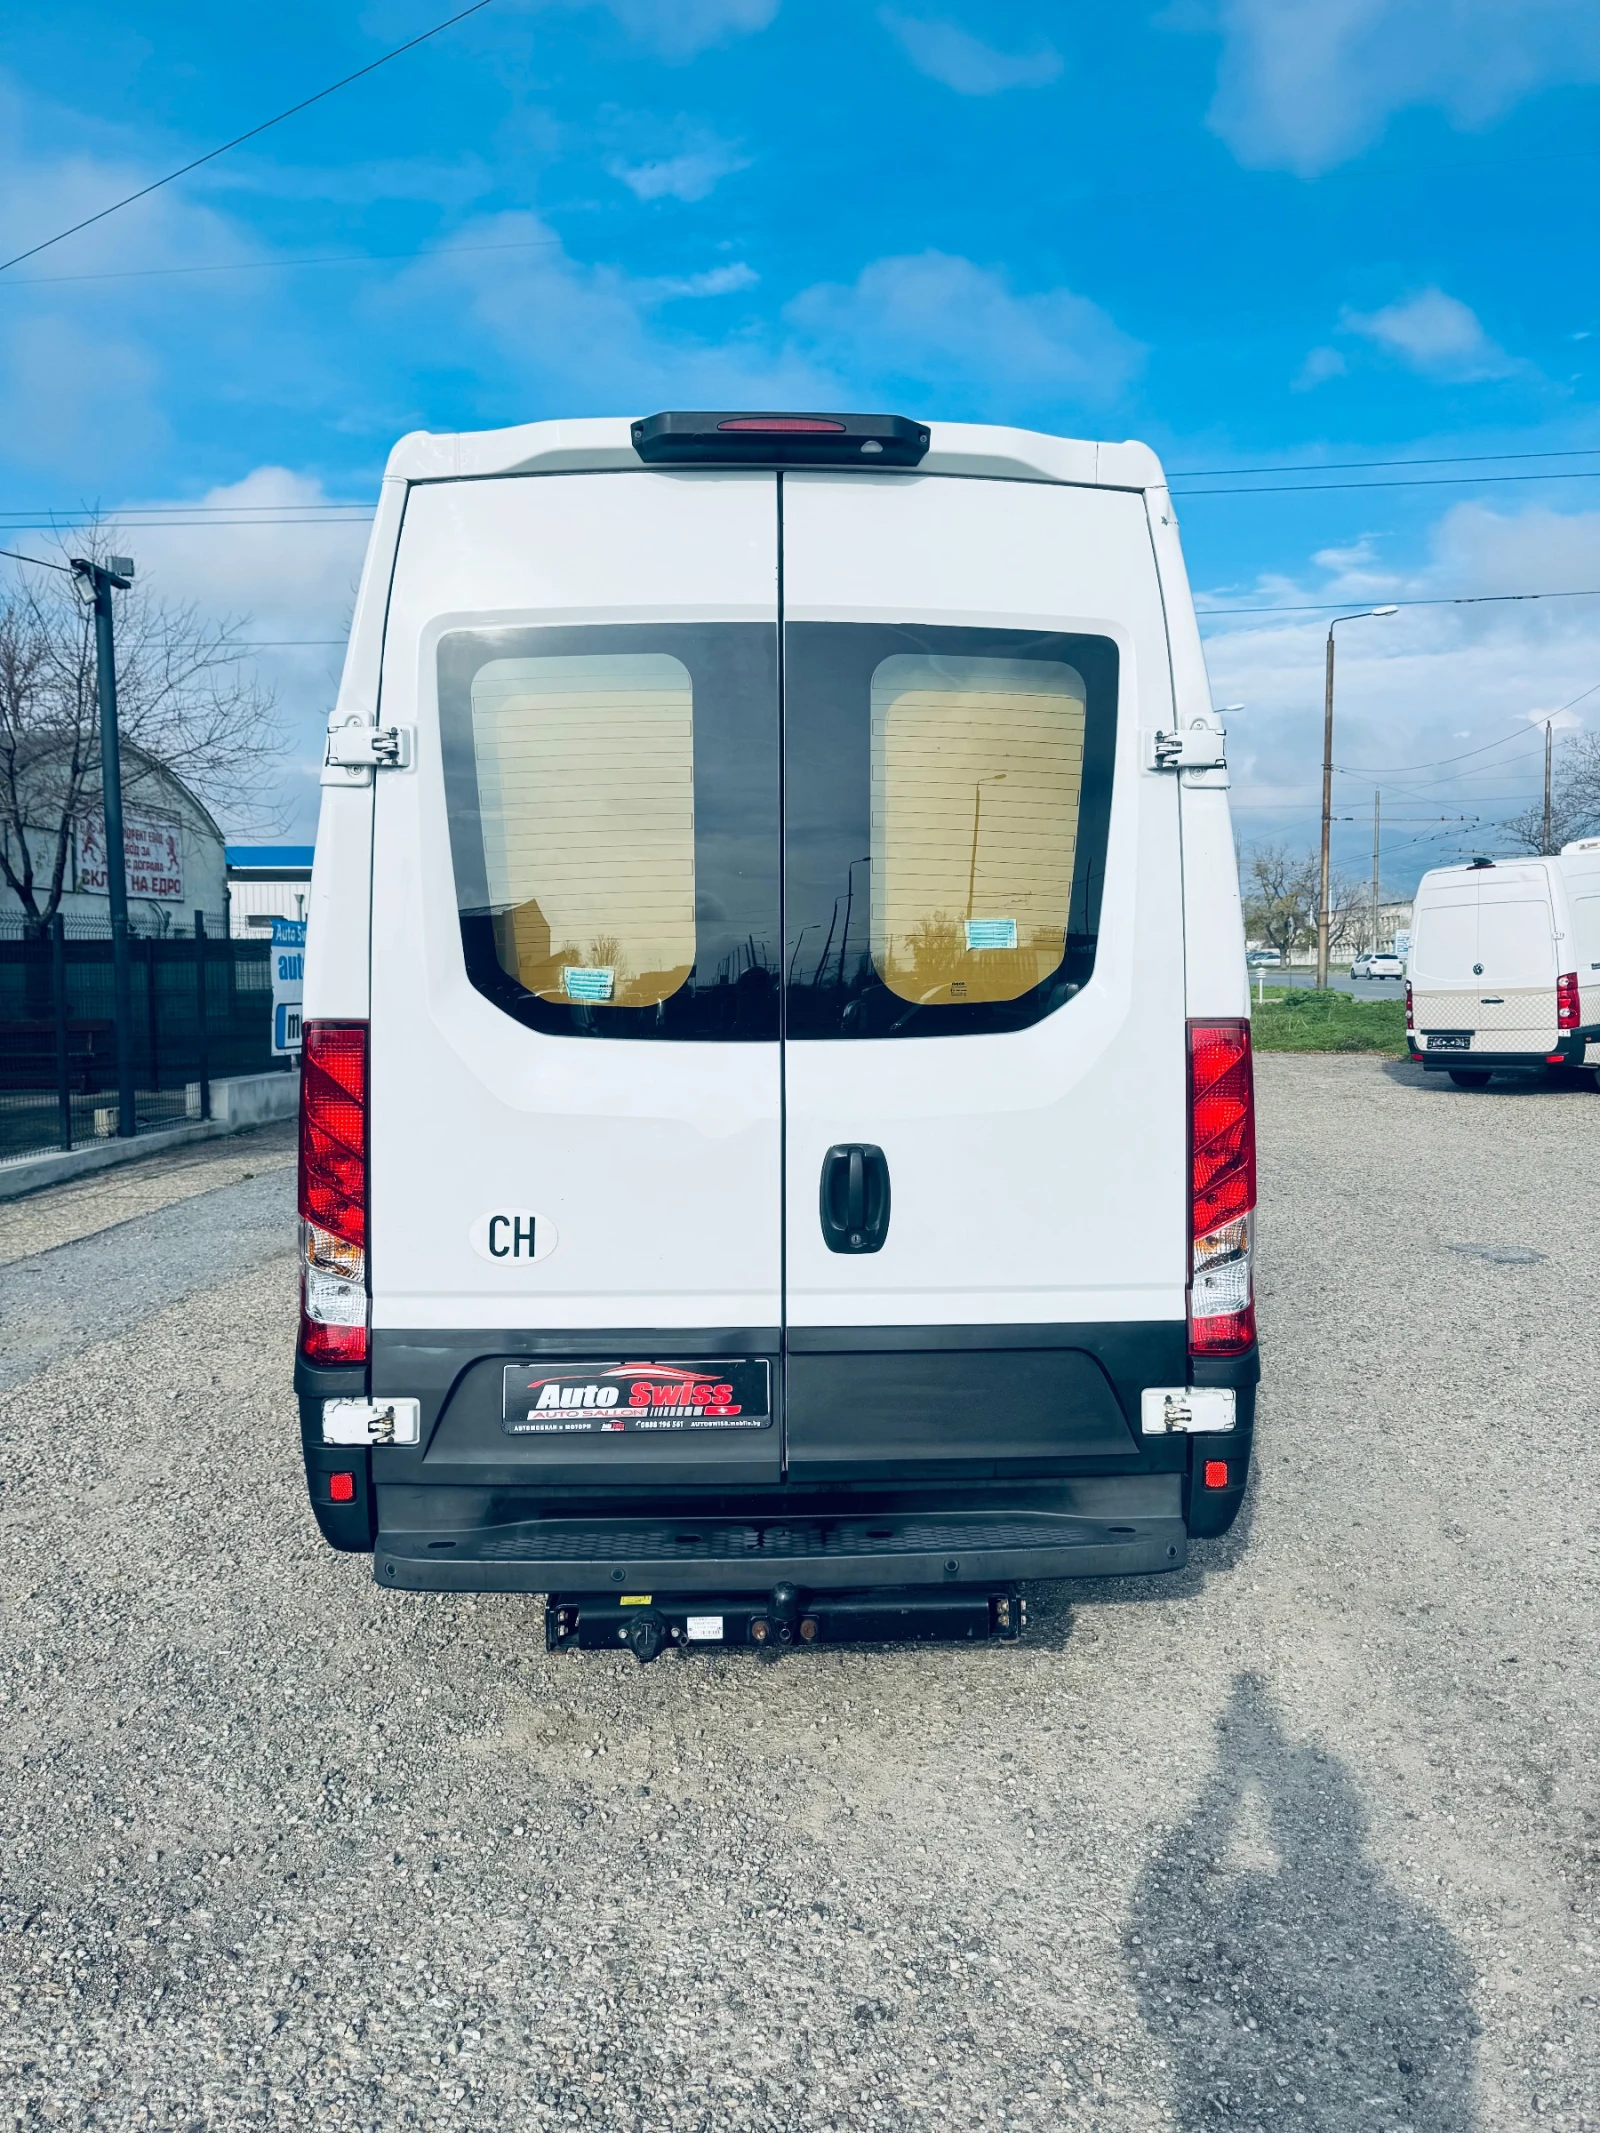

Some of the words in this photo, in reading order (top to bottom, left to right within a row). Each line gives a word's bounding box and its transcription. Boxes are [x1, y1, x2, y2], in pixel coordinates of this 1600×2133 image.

[131, 875, 148, 892] НА
[151, 877, 181, 896] ЕДРО
[275, 923, 296, 942] Auto
[277, 952, 305, 980] aut
[489, 1215, 535, 1258] CH
[535, 1384, 620, 1409] Auto
[628, 1381, 733, 1406] Swiss
[535, 1409, 580, 1418] AUTO
[582, 1409, 645, 1417] SALLON
